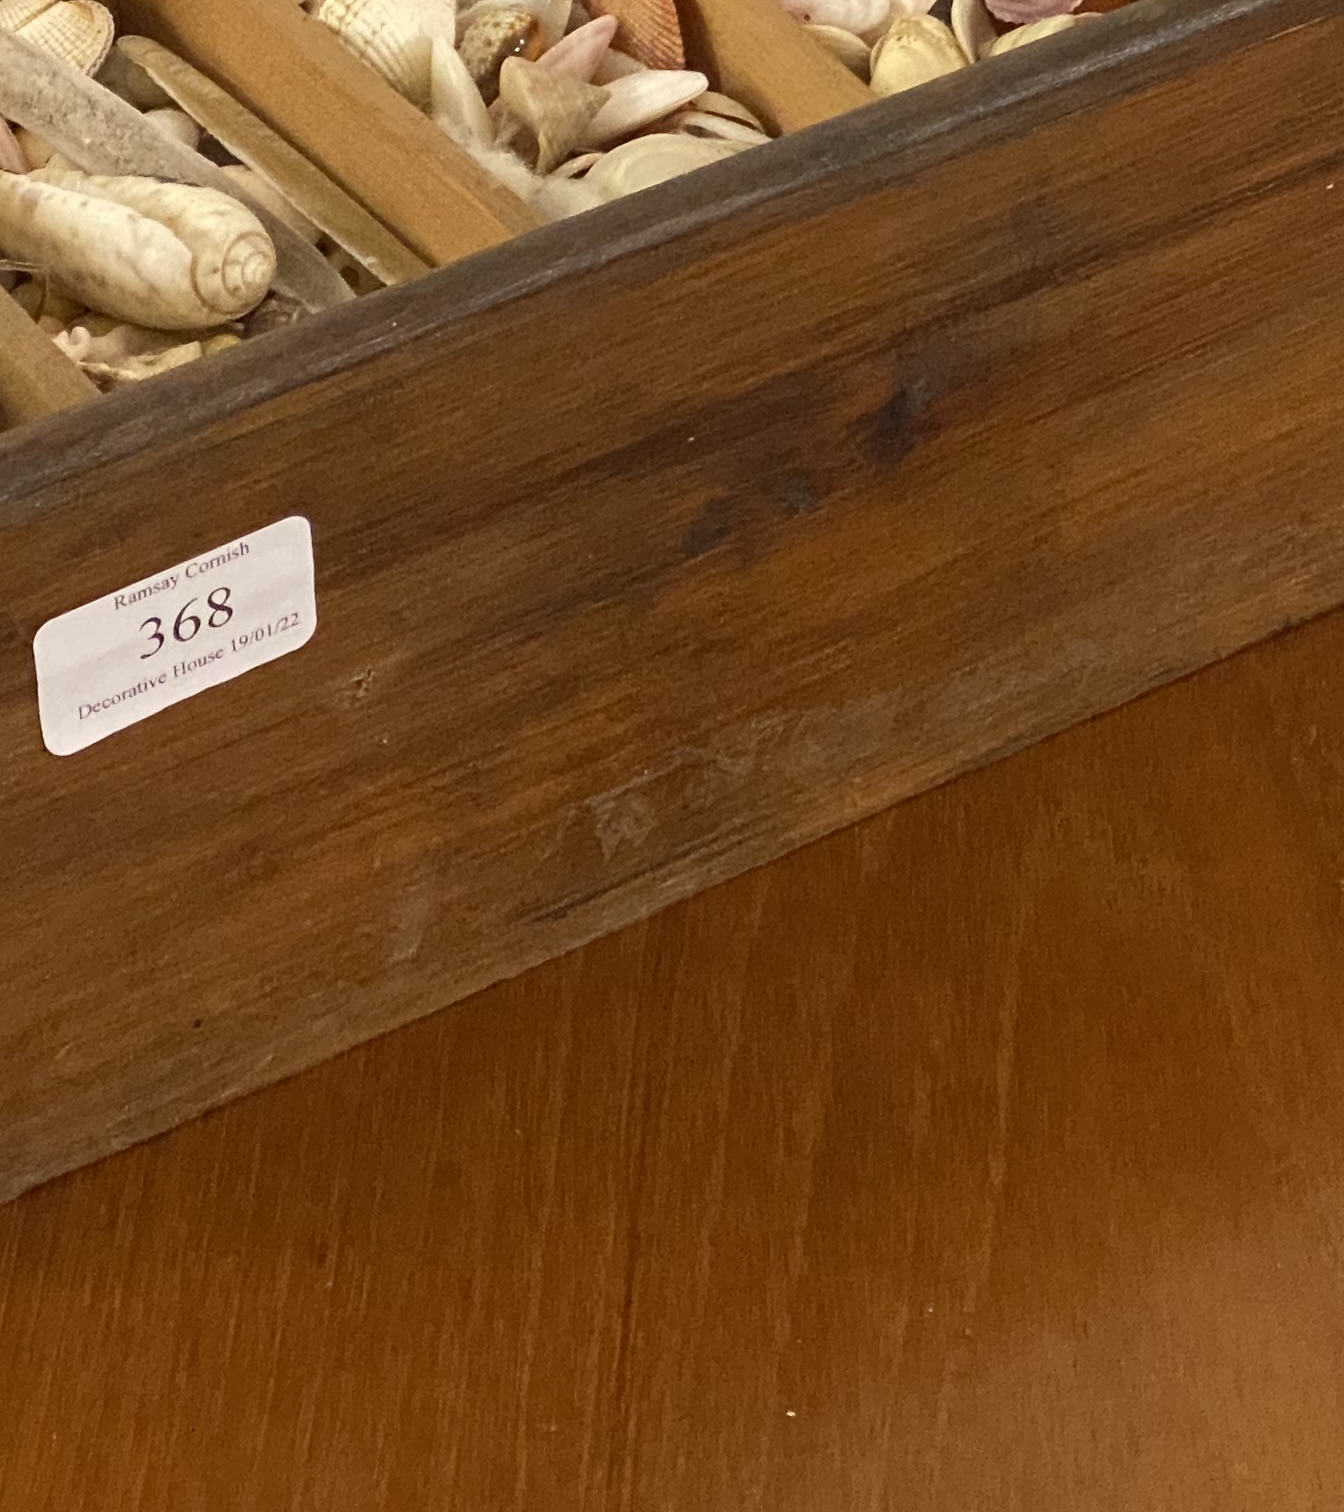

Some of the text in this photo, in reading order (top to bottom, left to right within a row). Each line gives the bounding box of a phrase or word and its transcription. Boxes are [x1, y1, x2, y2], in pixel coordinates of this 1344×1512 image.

[114, 543, 250, 610] Ramsay Cornish
[139, 587, 233, 659] 368
[78, 613, 299, 720] Decorative House 19/01/22
